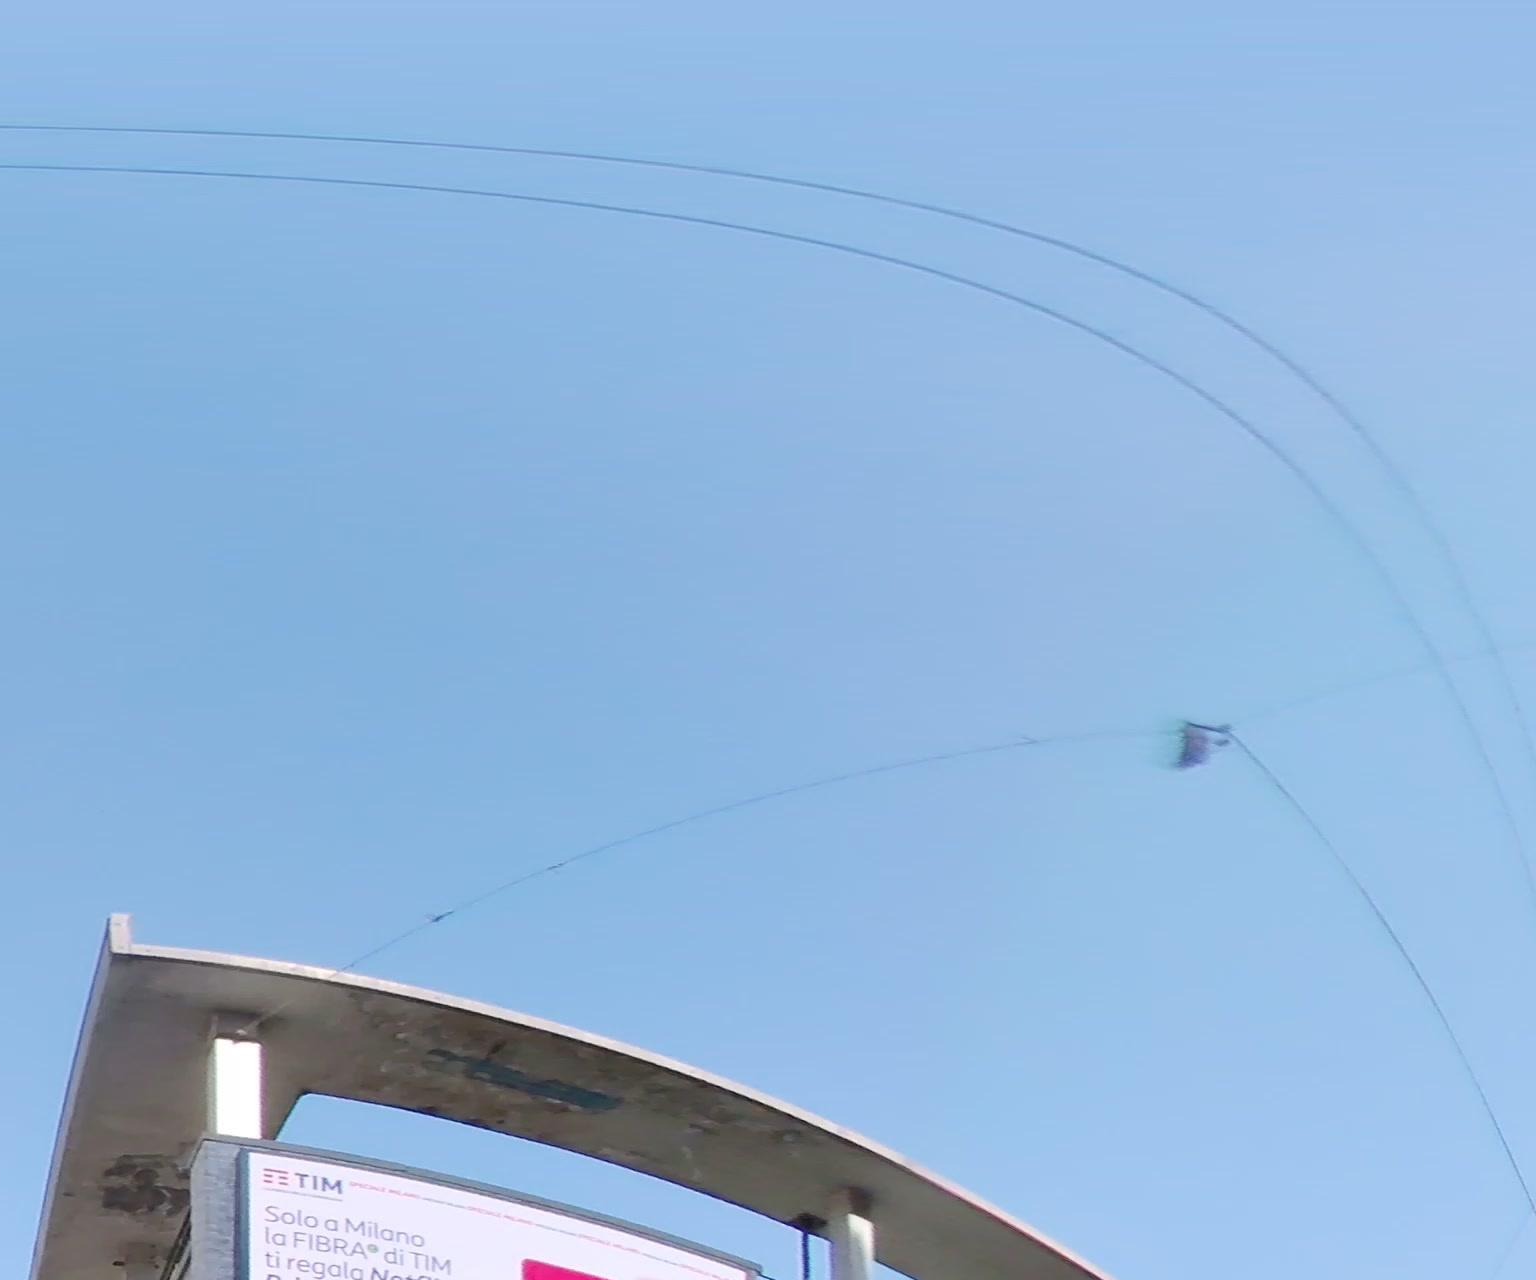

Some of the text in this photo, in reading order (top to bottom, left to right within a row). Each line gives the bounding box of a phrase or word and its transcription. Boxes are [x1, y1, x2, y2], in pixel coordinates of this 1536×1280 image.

[295, 1173, 344, 1194] TIM
[264, 1205, 425, 1247] Solo a Milano
[264, 1227, 287, 1247] la
[384, 1248, 405, 1267] di
[407, 1251, 452, 1276] TIM
[264, 1251, 281, 1270] ti
